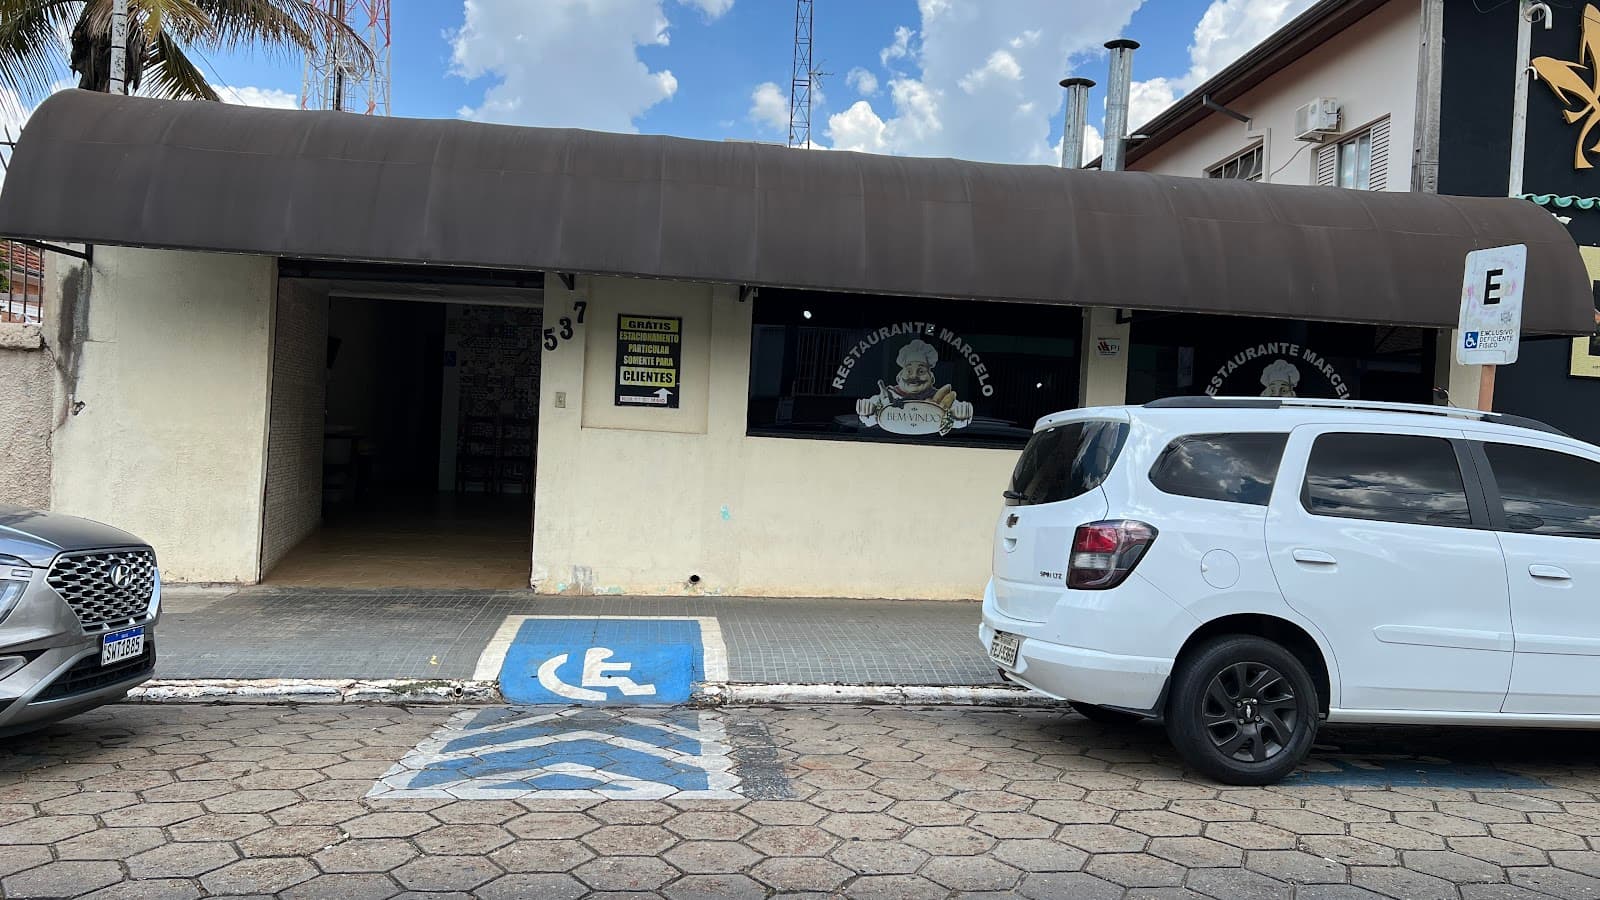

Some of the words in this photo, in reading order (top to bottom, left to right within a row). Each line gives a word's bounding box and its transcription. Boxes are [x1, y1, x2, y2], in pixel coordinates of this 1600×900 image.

[1483, 268, 1504, 306] E
[543, 301, 587, 351] 537
[619, 331, 679, 343] ESTACIONAMENTO
[1479, 335, 1513, 343] DEFICIENTE
[628, 343, 670, 355] PARTICULAR
[623, 355, 655, 366] SOMENTE
[655, 357, 673, 367] PARA
[832, 321, 936, 391] RESTAURANTE
[939, 327, 994, 397] MARCELO
[1204, 342, 1300, 397] ESTAURANTE
[623, 370, 673, 384] CLIENTES
